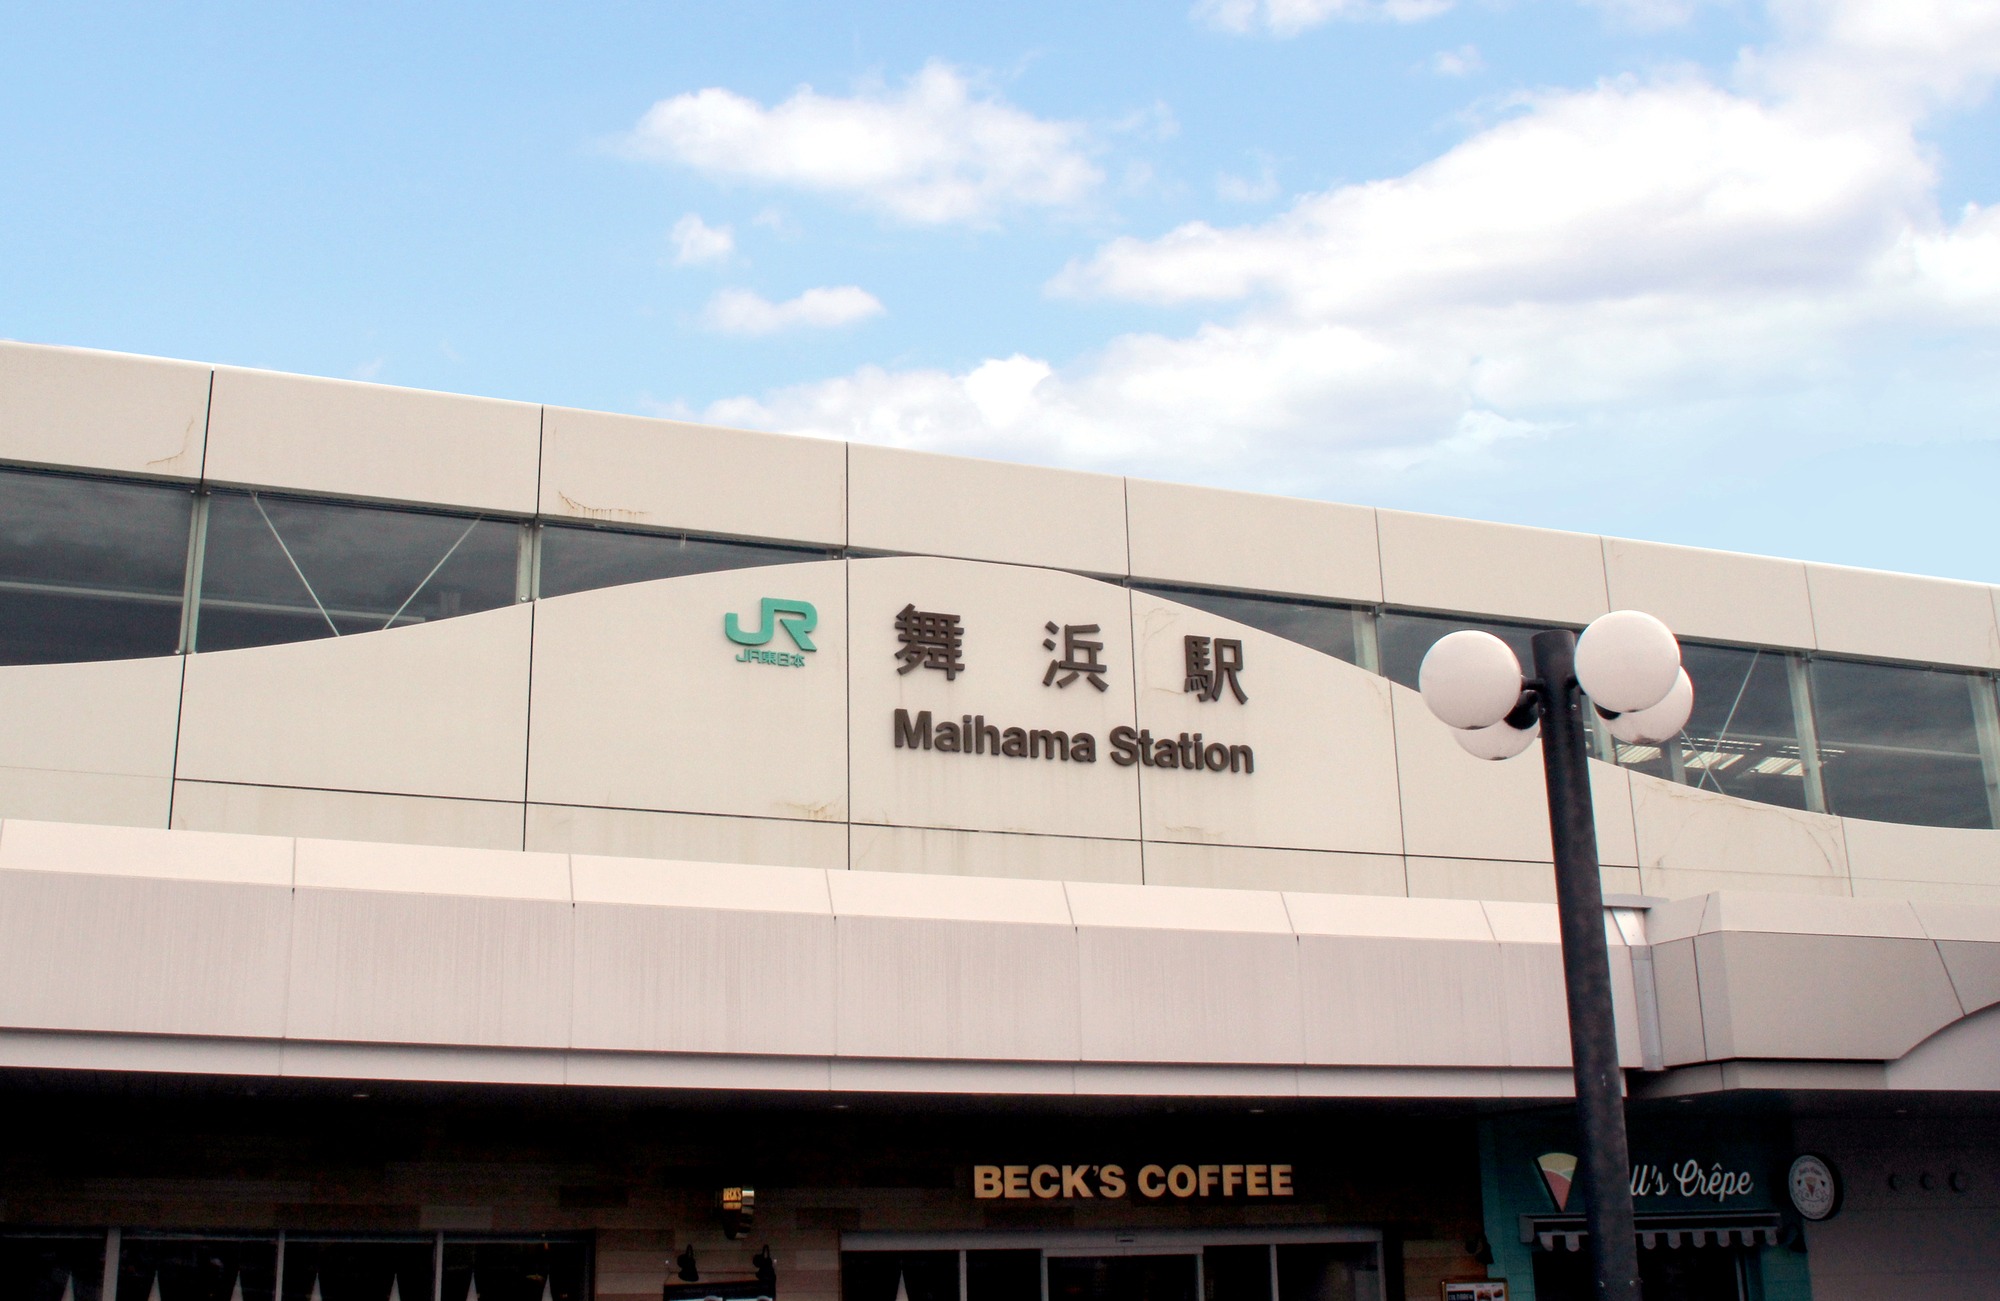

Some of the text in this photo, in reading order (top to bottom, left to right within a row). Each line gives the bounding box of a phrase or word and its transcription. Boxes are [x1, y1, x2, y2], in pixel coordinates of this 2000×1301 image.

[724, 597, 818, 652] JR
[735, 648, 806, 668] JR東日本
[894, 603, 1249, 705] 舞浜駅
[894, 708, 1255, 774] Maihama Station
[973, 1163, 1295, 1199] BECK'S COFFEE
[1629, 1158, 1755, 1203] ll's Crêpe
